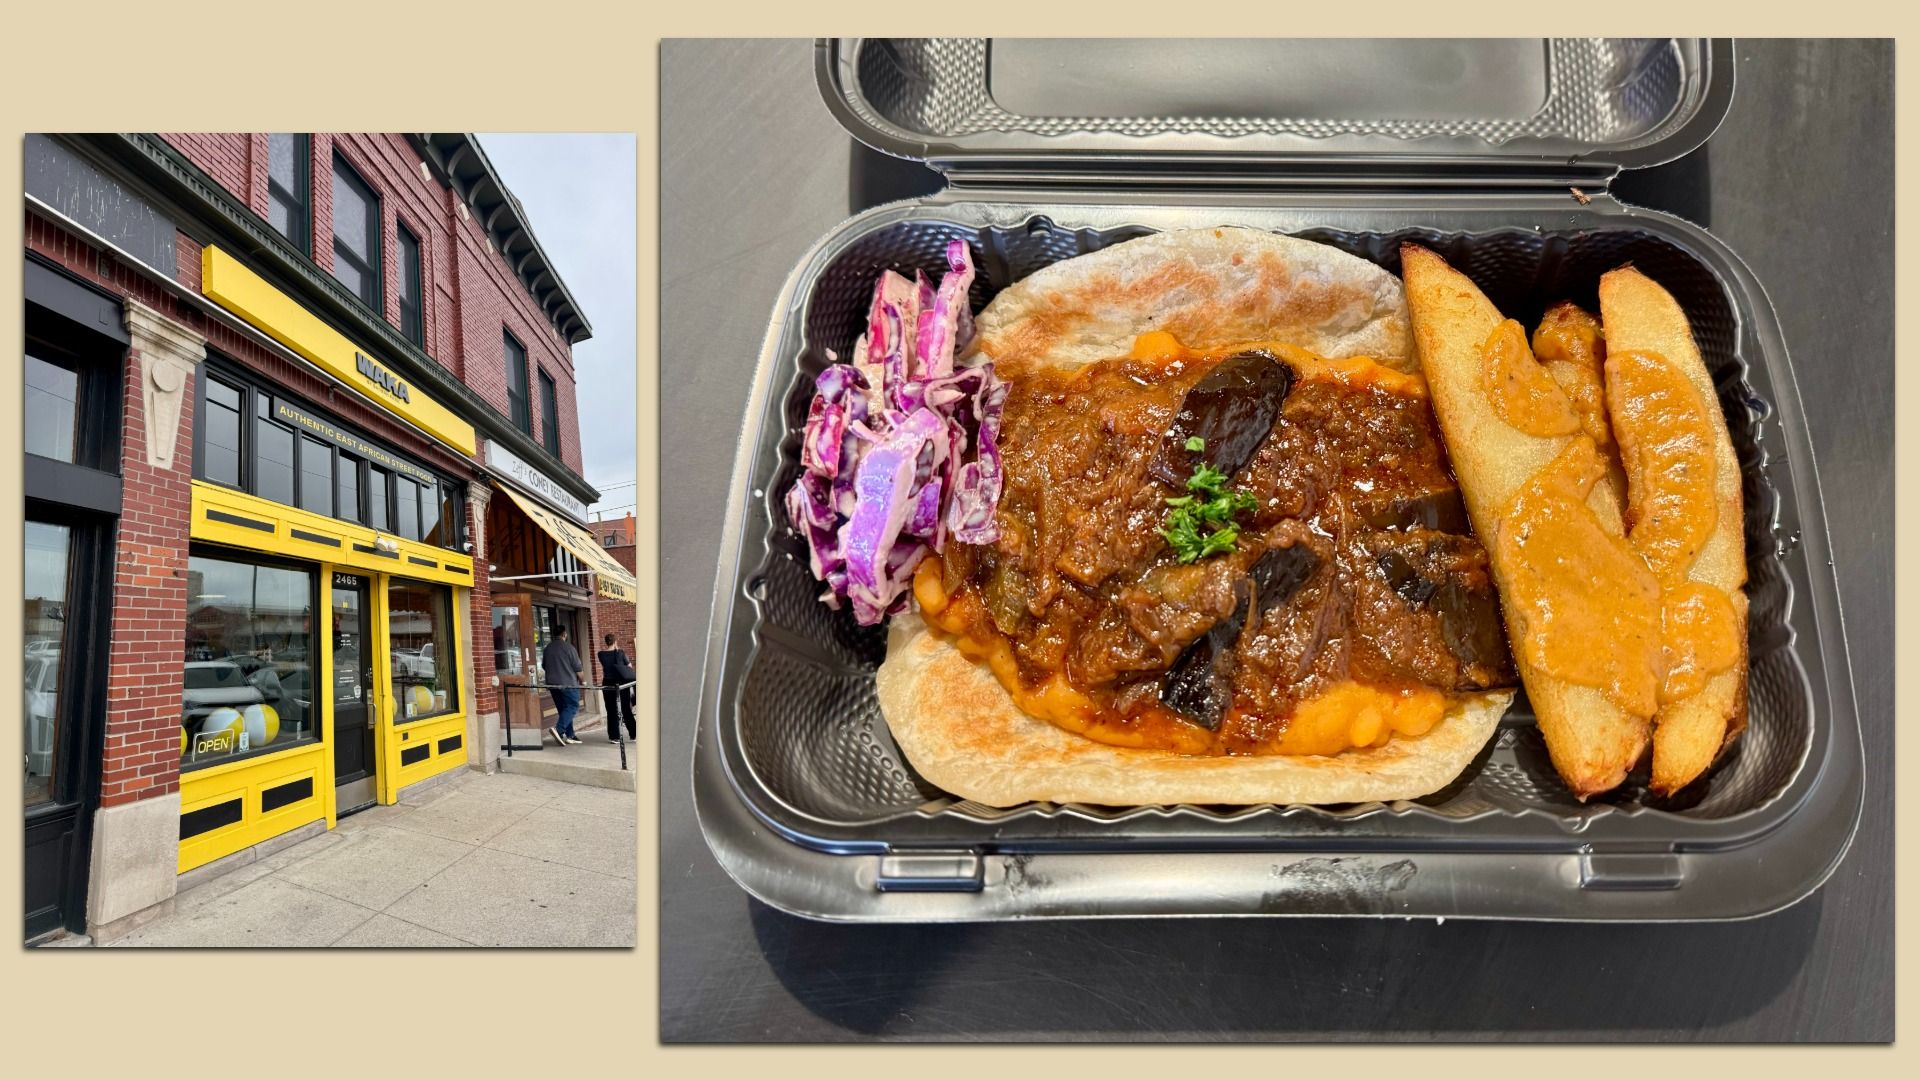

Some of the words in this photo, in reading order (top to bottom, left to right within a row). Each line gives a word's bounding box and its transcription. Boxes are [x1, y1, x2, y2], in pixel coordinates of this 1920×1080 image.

[355, 352, 410, 404] WAKA
[280, 405, 334, 437] AUTHENTIC
[336, 432, 357, 448] EAST
[359, 443, 390, 464] AFRICAN
[392, 459, 415, 475] STREET
[416, 470, 432, 483] FOOD
[336, 574, 357, 585] 2465
[198, 737, 230, 753] OPEN
